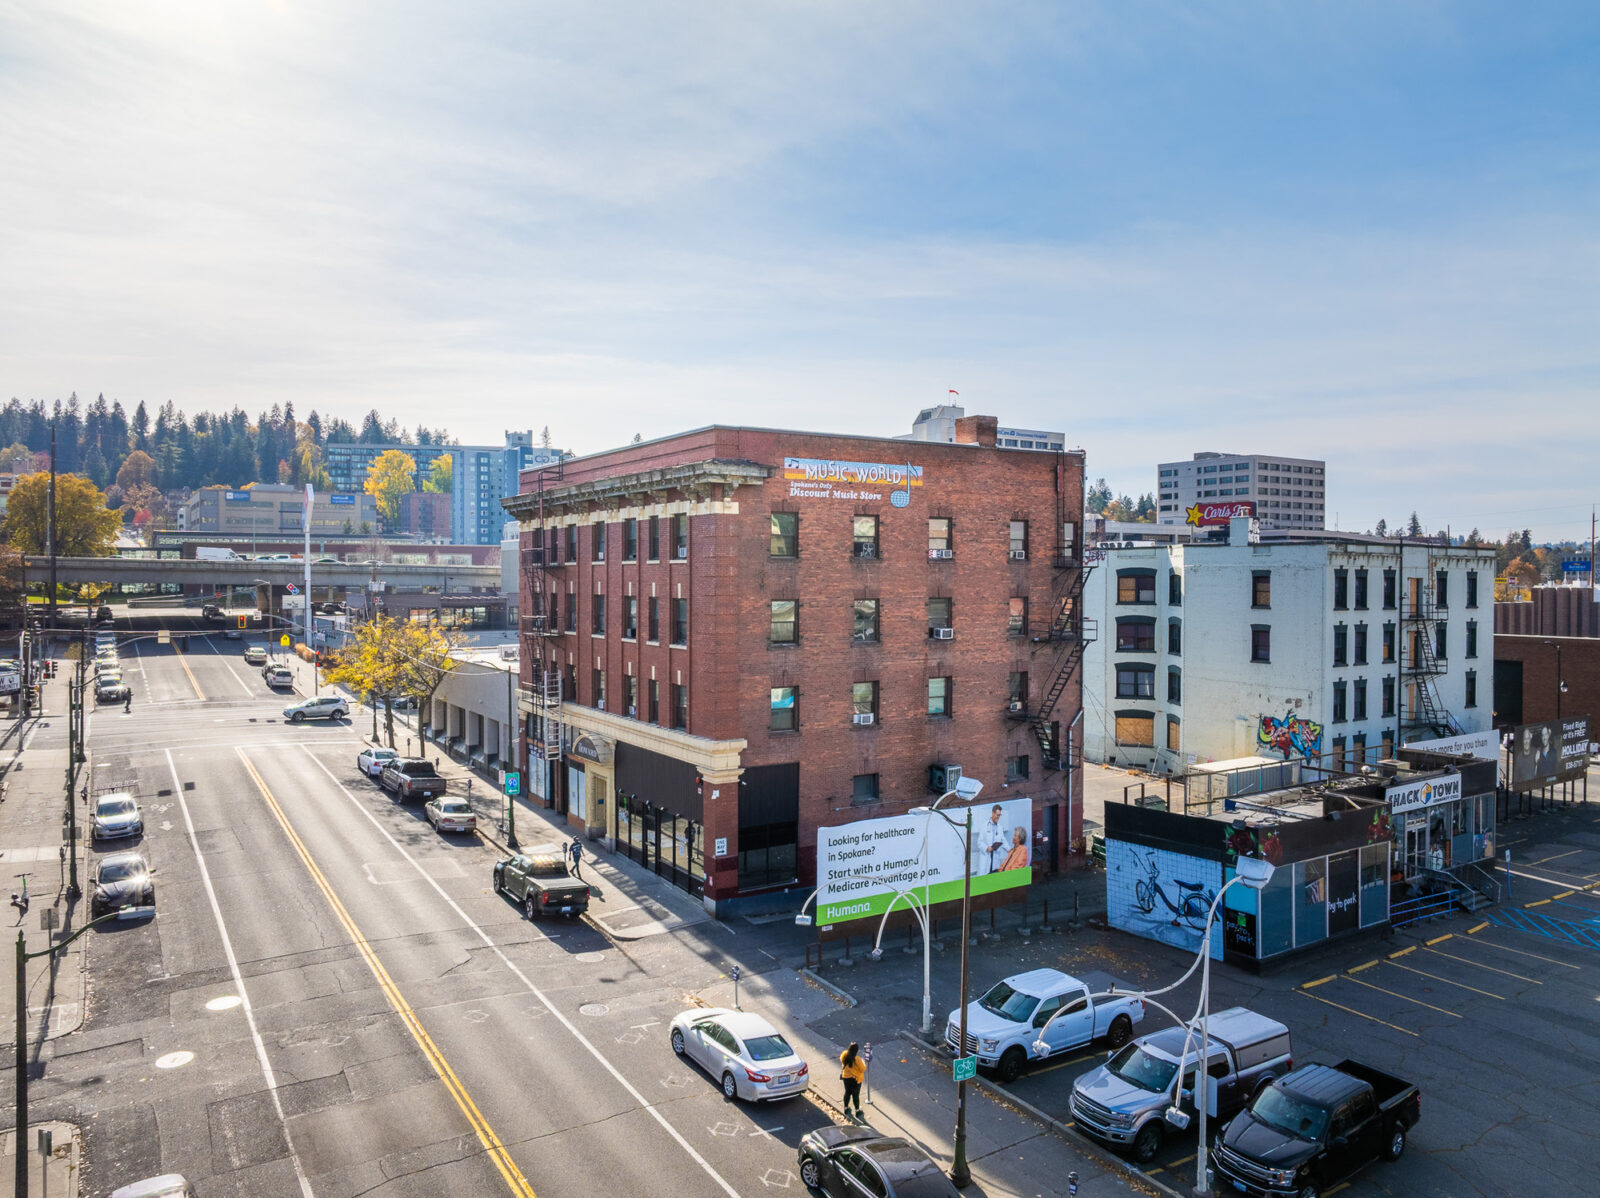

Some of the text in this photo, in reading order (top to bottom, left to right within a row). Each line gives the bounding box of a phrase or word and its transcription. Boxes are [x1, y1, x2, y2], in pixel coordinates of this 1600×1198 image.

[805, 461, 901, 484] MUSIC WORLD
[790, 481, 832, 490] Spokane's Only
[790, 488, 882, 500] Discount Music Store
[1204, 506, 1231, 519] Carl's
[1575, 721, 1586, 730] Right
[1575, 729, 1586, 737] FREE
[1437, 744, 1454, 753] more
[1454, 741, 1463, 751] for
[1464, 742, 1474, 751] you
[1475, 739, 1488, 748] than
[1562, 741, 1588, 755] HOLLIDAY
[508, 779, 517, 787] 90
[1388, 781, 1459, 807] SHACK TOWN
[828, 826, 915, 847] Looking for healthcare
[828, 846, 876, 861] in Spokane?
[828, 868, 851, 880] Start
[853, 864, 874, 876] with
[883, 857, 919, 871] Humana
[828, 879, 870, 894] Medicare
[920, 867, 941, 880] pan.
[1336, 897, 1343, 908] to
[1343, 892, 1357, 911] park
[827, 902, 870, 919] Humana
